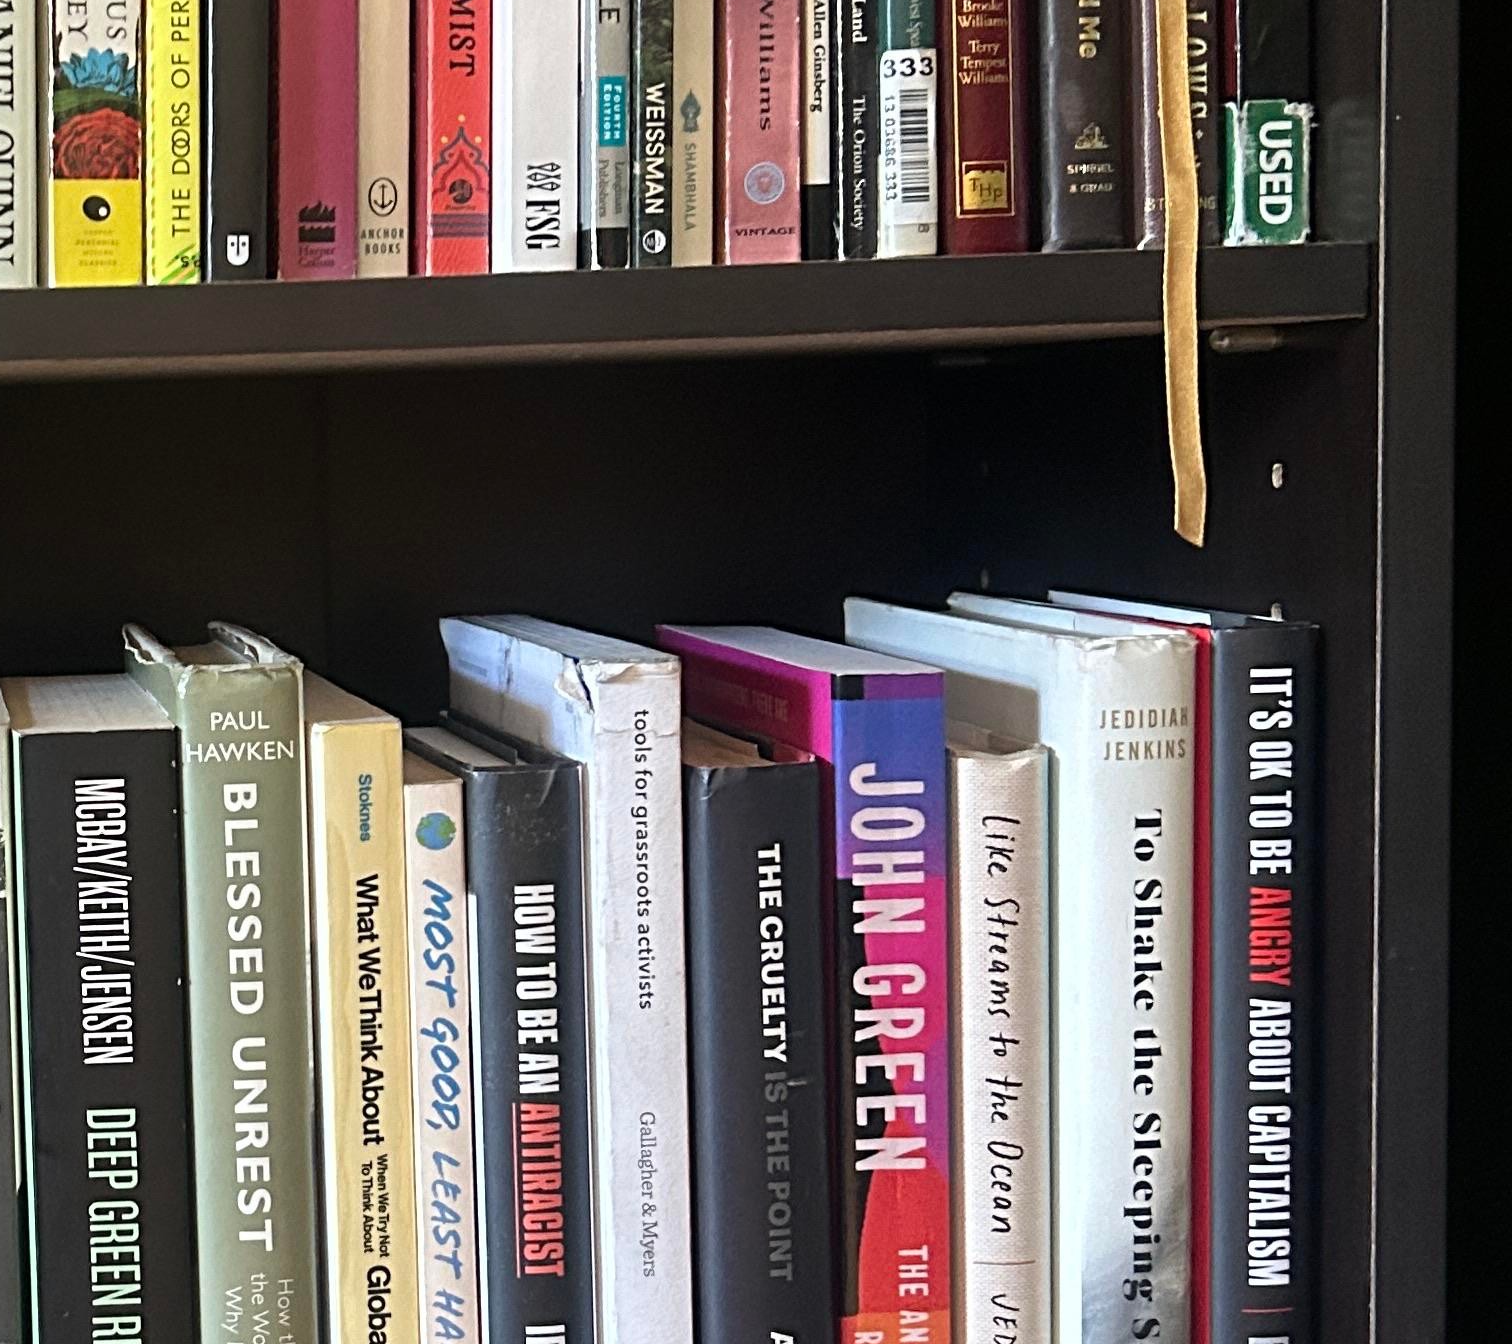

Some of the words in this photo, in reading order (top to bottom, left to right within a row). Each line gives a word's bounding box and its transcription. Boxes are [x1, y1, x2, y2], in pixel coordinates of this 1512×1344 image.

[170, 53, 190, 88] OF
[809, 45, 826, 113] Ginsberg
[170, 102, 190, 174] DOORS
[645, 82, 666, 214] WEISSMAN
[1258, 119, 1293, 224] USED
[170, 187, 190, 238] THE
[684, 142, 697, 231] SHAMBHALA
[525, 199, 561, 250] FSG
[185, 740, 296, 763] HAWKEN
[209, 711, 272, 731] PAUL
[359, 773, 374, 842] Stoknes
[1134, 808, 1163, 862] To
[847, 762, 926, 934] JOHN
[72, 777, 136, 1064] MCBAY/KEITH/JENSEN
[222, 782, 265, 1015] BLESSED
[514, 884, 557, 954] HOW
[516, 961, 557, 1000] TO
[1133, 879, 1164, 1011] Shake
[517, 1008, 559, 1045] BE
[1134, 1027, 1164, 1096] the
[518, 1051, 560, 1093] AN
[852, 961, 927, 1171] GREEN
[85, 1107, 139, 1189] DEEP
[233, 1035, 273, 1252] UNREST
[520, 1102, 565, 1277] ANTIRACIST
[1122, 1111, 1163, 1303] Sleeping
[87, 1200, 143, 1305] GREEN
[898, 1244, 929, 1297] THE
